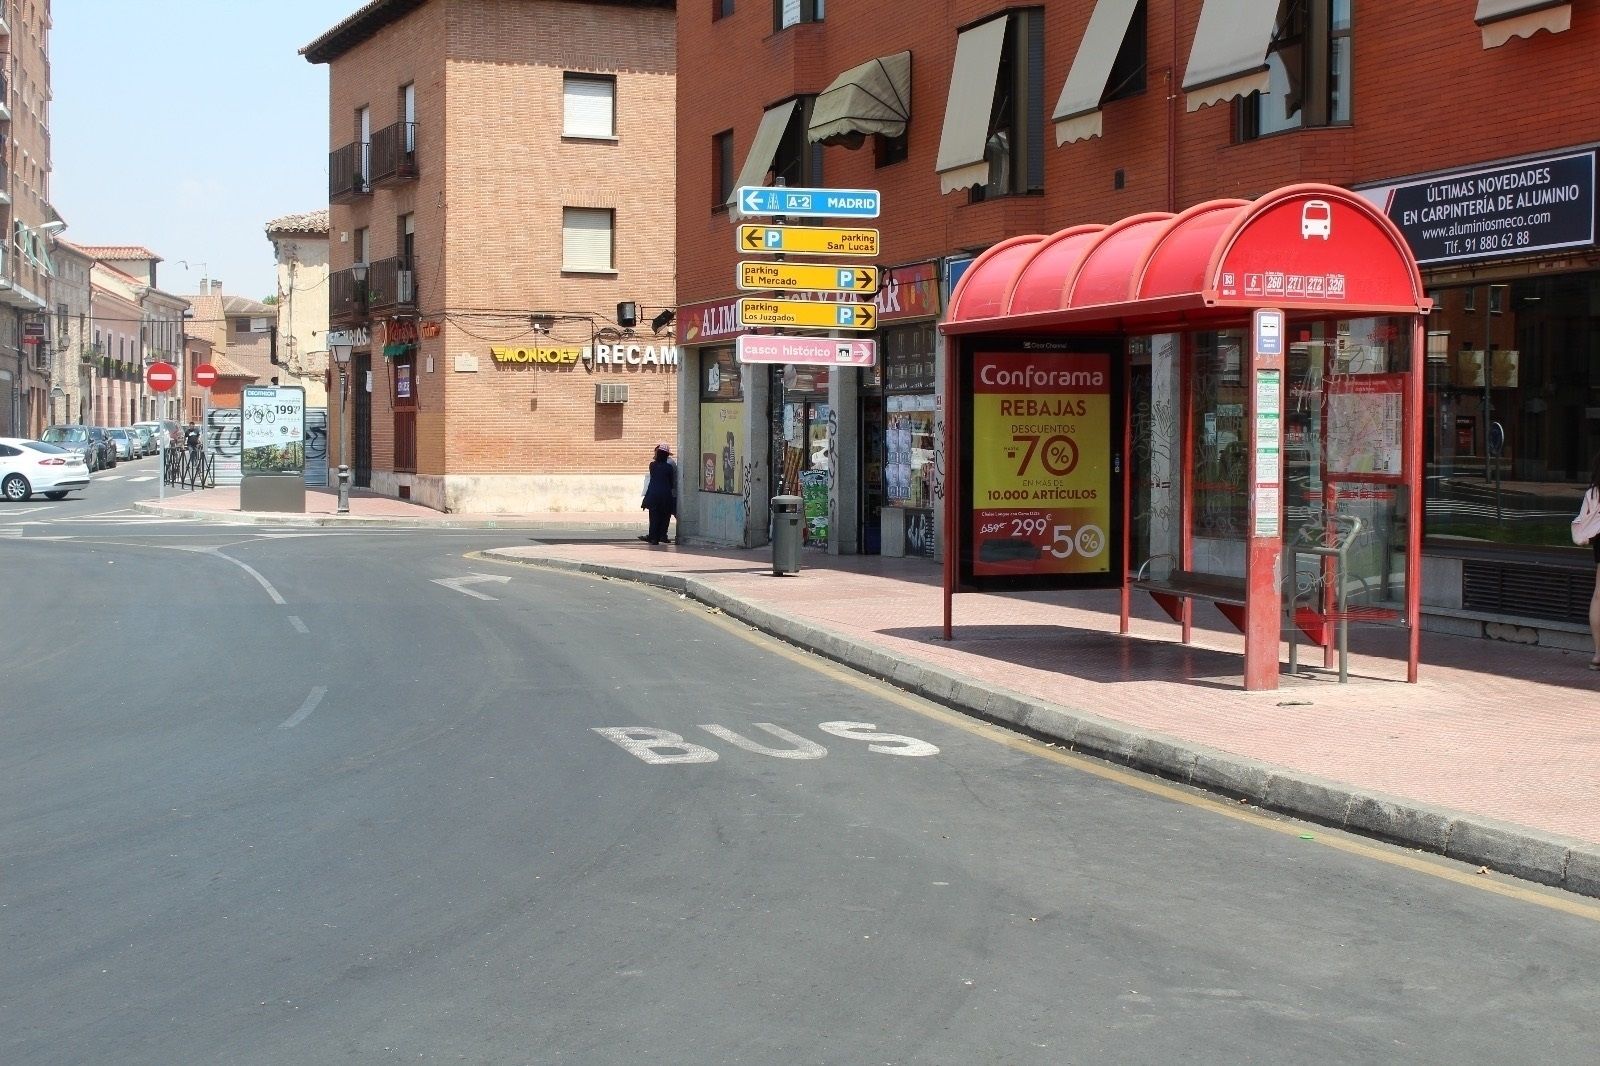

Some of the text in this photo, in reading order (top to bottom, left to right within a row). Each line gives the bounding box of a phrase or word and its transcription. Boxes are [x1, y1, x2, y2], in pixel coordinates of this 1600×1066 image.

[1427, 167, 1551, 203] ÚLTIMAS NOVEDADES
[788, 196, 875, 209] A-2 MADRID
[1403, 184, 1579, 226] EN CARPINTERÍA DE ALUMINIO
[1422, 210, 1551, 240] www.aluminiosmeco.com
[841, 233, 875, 244] parking
[1444, 231, 1530, 255] Tlf. 91 880 62 88
[827, 241, 875, 252] San Lucas
[744, 265, 779, 277] parking
[744, 275, 797, 286] El Mercado
[1266, 276, 1282, 289] 260
[1288, 277, 1302, 290] 271
[1307, 278, 1322, 291] 272
[1328, 279, 1343, 291] 320
[744, 302, 779, 314] parking
[744, 312, 795, 324] Los Juzgados
[503, 347, 570, 363] MONROE
[744, 345, 778, 356] casco
[980, 363, 1105, 388] Conforama
[1000, 399, 1087, 417] REBAJAS
[1011, 424, 1076, 434] DESCUENTOS
[1022, 479, 1034, 487] EN
[987, 487, 1097, 501] 10.000 ARTÍCULOS
[590, 720, 940, 765] BUS
